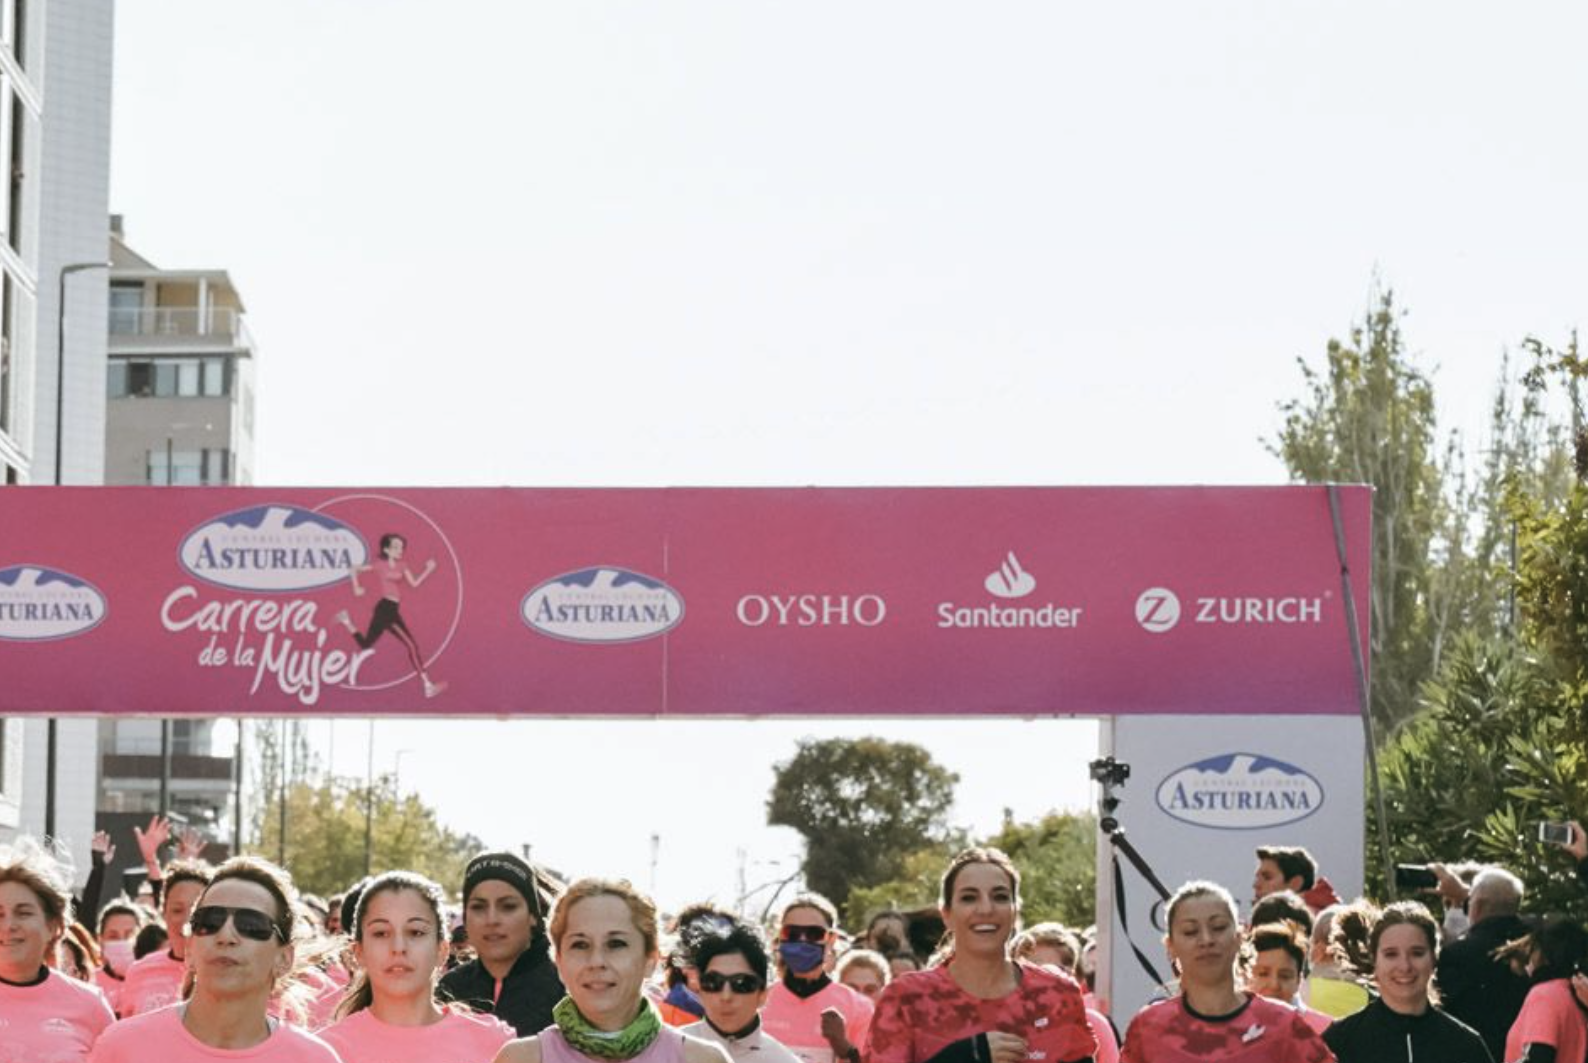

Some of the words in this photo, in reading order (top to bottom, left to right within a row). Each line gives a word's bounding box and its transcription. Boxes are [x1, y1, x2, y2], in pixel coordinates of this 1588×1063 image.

[194, 536, 352, 570] ASTURIANA
[161, 585, 319, 632] Carrera
[535, 595, 671, 622] ASTURIANA
[736, 594, 887, 627] OYSHO
[937, 603, 1081, 628] Santander
[1196, 598, 1321, 623] ZURICH
[198, 634, 228, 666] de
[233, 634, 255, 666] la
[250, 628, 375, 706] Mujer
[1168, 780, 1311, 810] ASTURIANA
